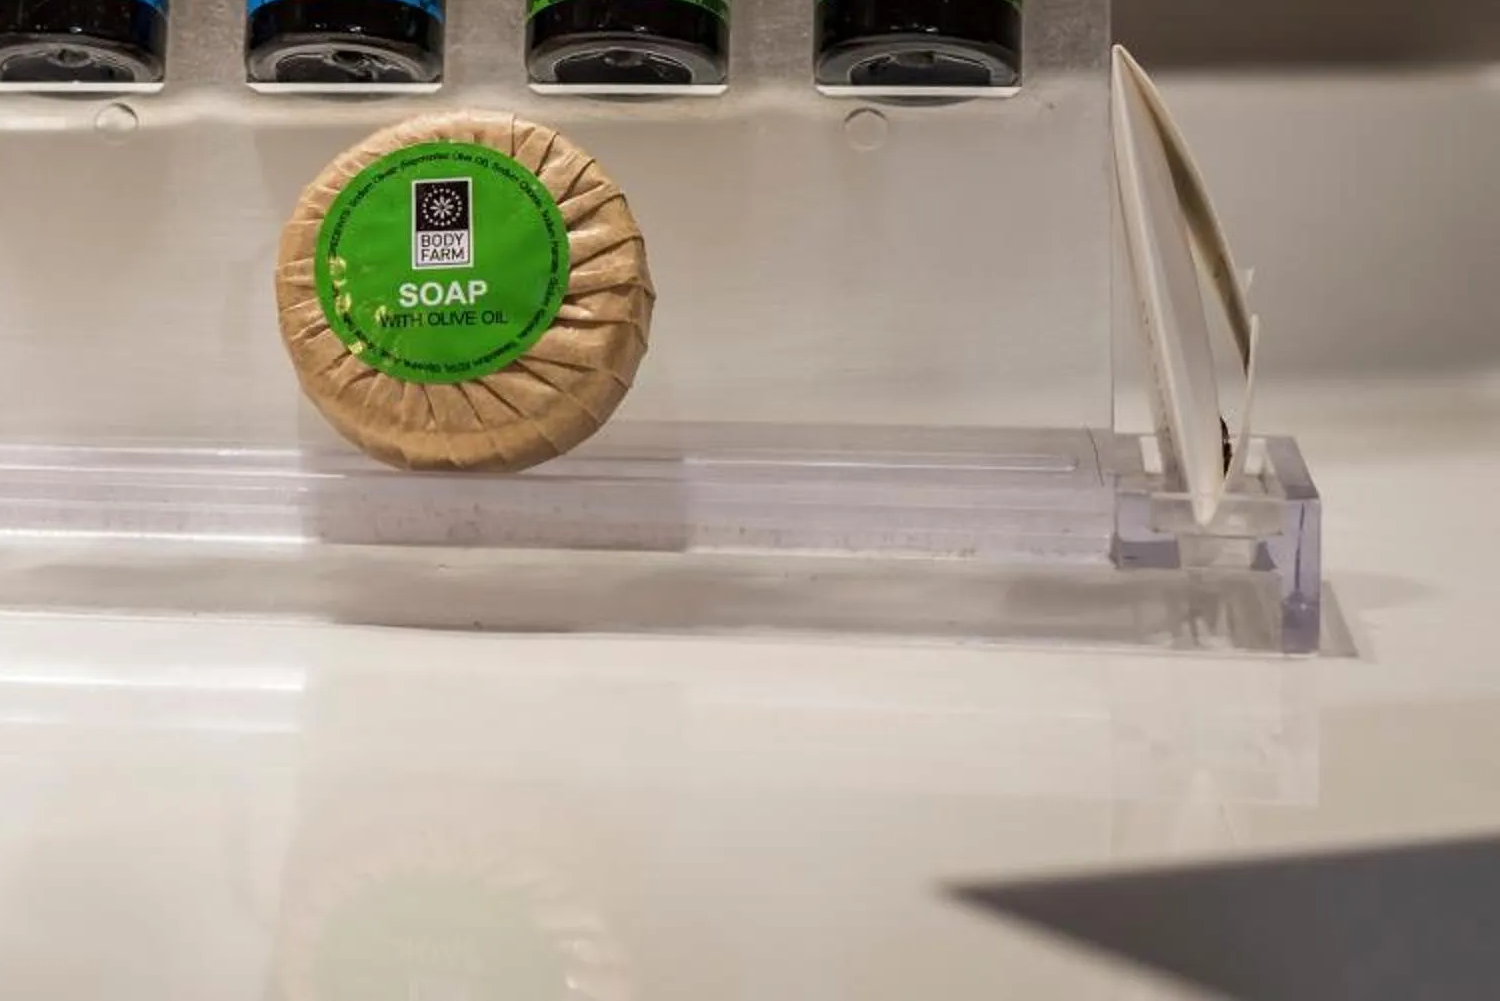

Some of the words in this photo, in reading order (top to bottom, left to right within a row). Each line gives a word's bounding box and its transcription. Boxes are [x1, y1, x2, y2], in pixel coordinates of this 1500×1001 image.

[420, 232, 465, 248] BODY
[420, 247, 465, 262] FARM
[399, 279, 489, 308] SOAP
[380, 313, 423, 328] WITH
[427, 311, 477, 326] OLIVE
[481, 309, 510, 325] OIL
